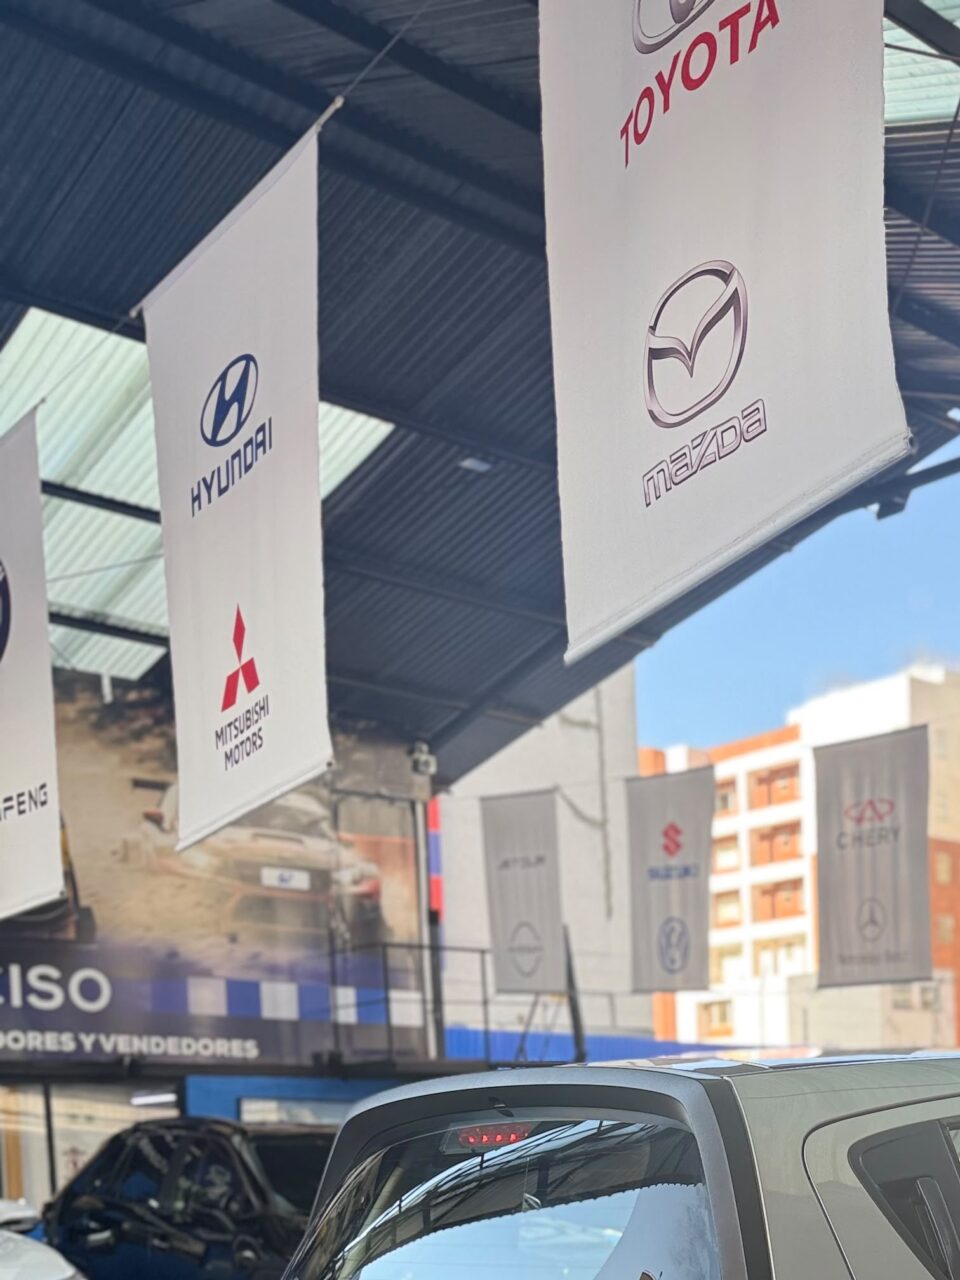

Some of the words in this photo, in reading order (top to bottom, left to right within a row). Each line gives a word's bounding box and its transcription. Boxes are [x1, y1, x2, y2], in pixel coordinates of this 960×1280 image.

[620, 0, 780, 169] TOYOTA
[191, 416, 272, 518] HYUNDAI
[215, 694, 270, 750] MITSUBISHI
[224, 726, 264, 771] MOTORS
[0, 782, 48, 822] FENG
[836, 826, 901, 850] CHERY
[0, 962, 112, 1013] ISO
[78, 1031, 99, 1053] Y
[100, 1033, 260, 1060] VENDEDORES
